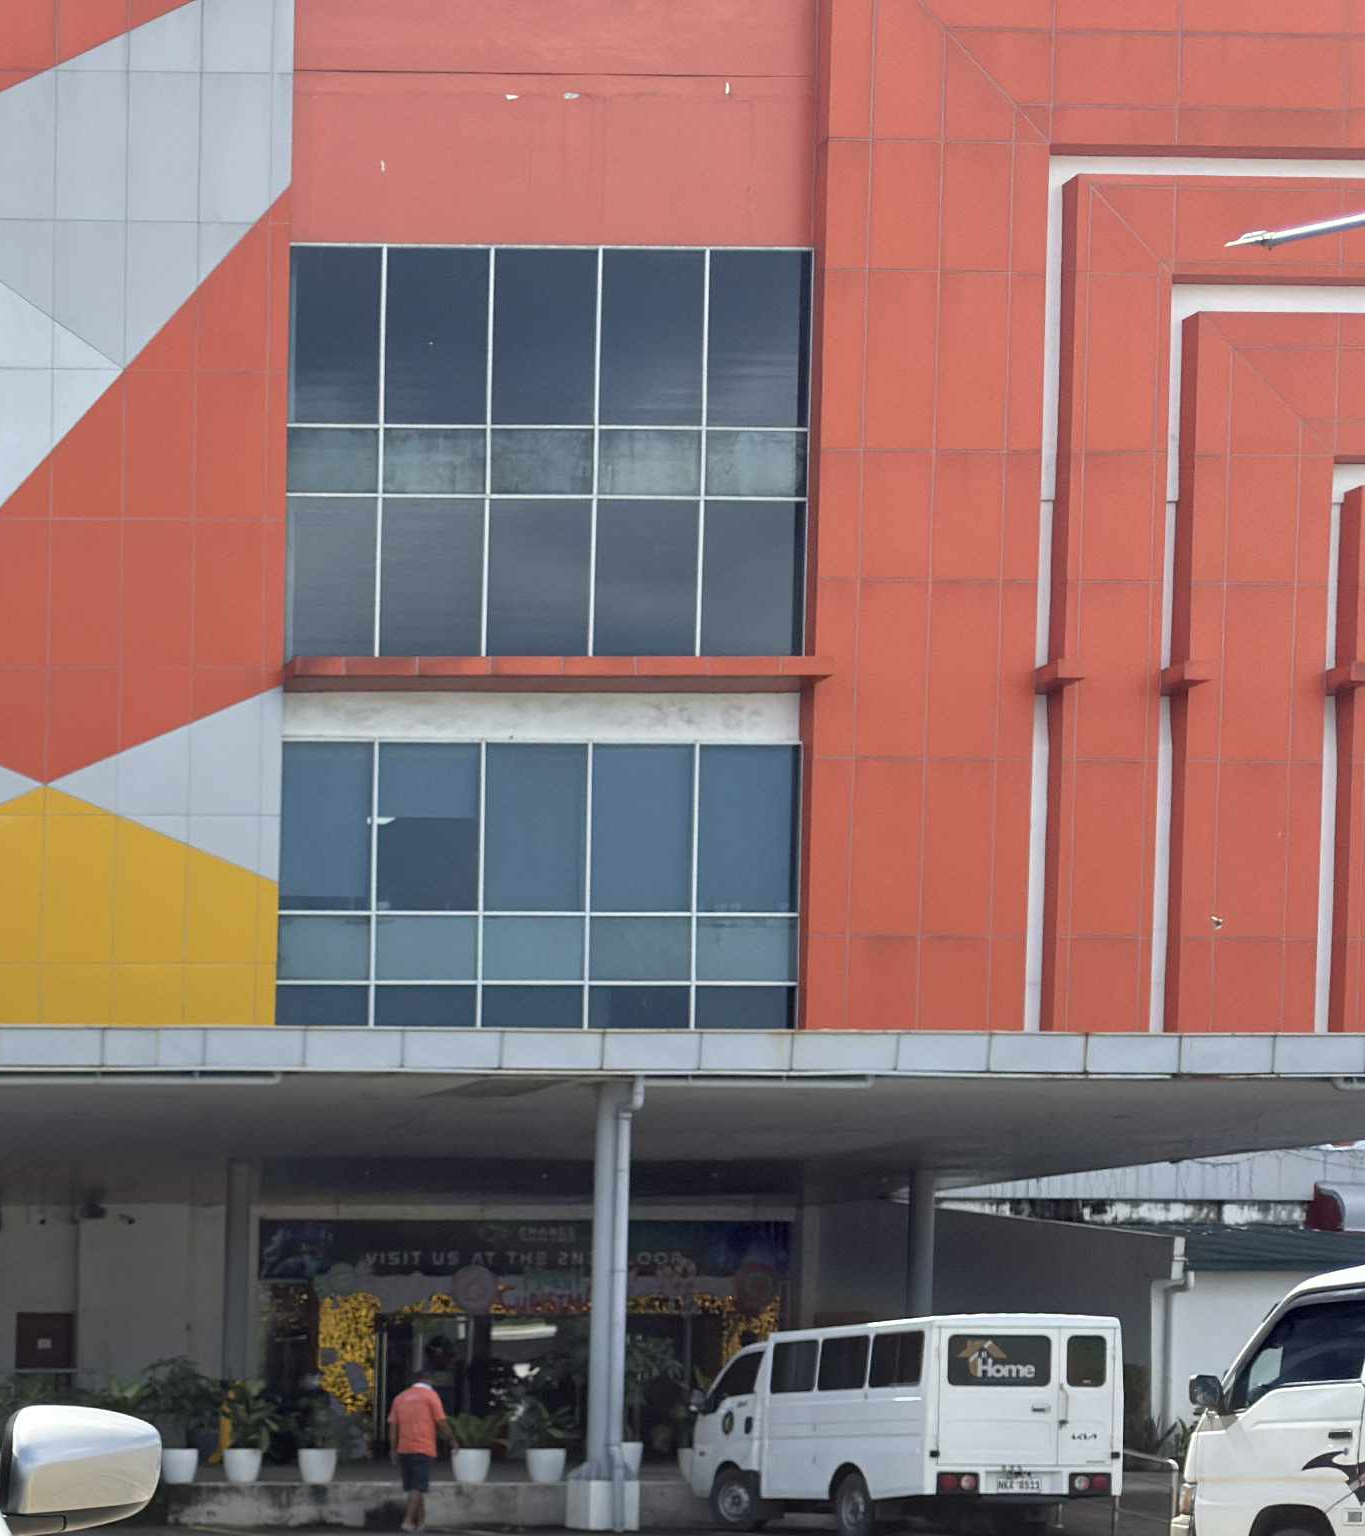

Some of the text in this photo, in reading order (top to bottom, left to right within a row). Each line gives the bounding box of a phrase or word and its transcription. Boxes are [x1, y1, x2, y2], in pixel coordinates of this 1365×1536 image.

[365, 1250, 422, 1265] VISIT
[432, 1250, 461, 1265] US
[471, 1251, 497, 1265] AT
[507, 1251, 548, 1265] THE
[558, 1251, 586, 1265] 2N
[977, 1357, 1036, 1378] Home
